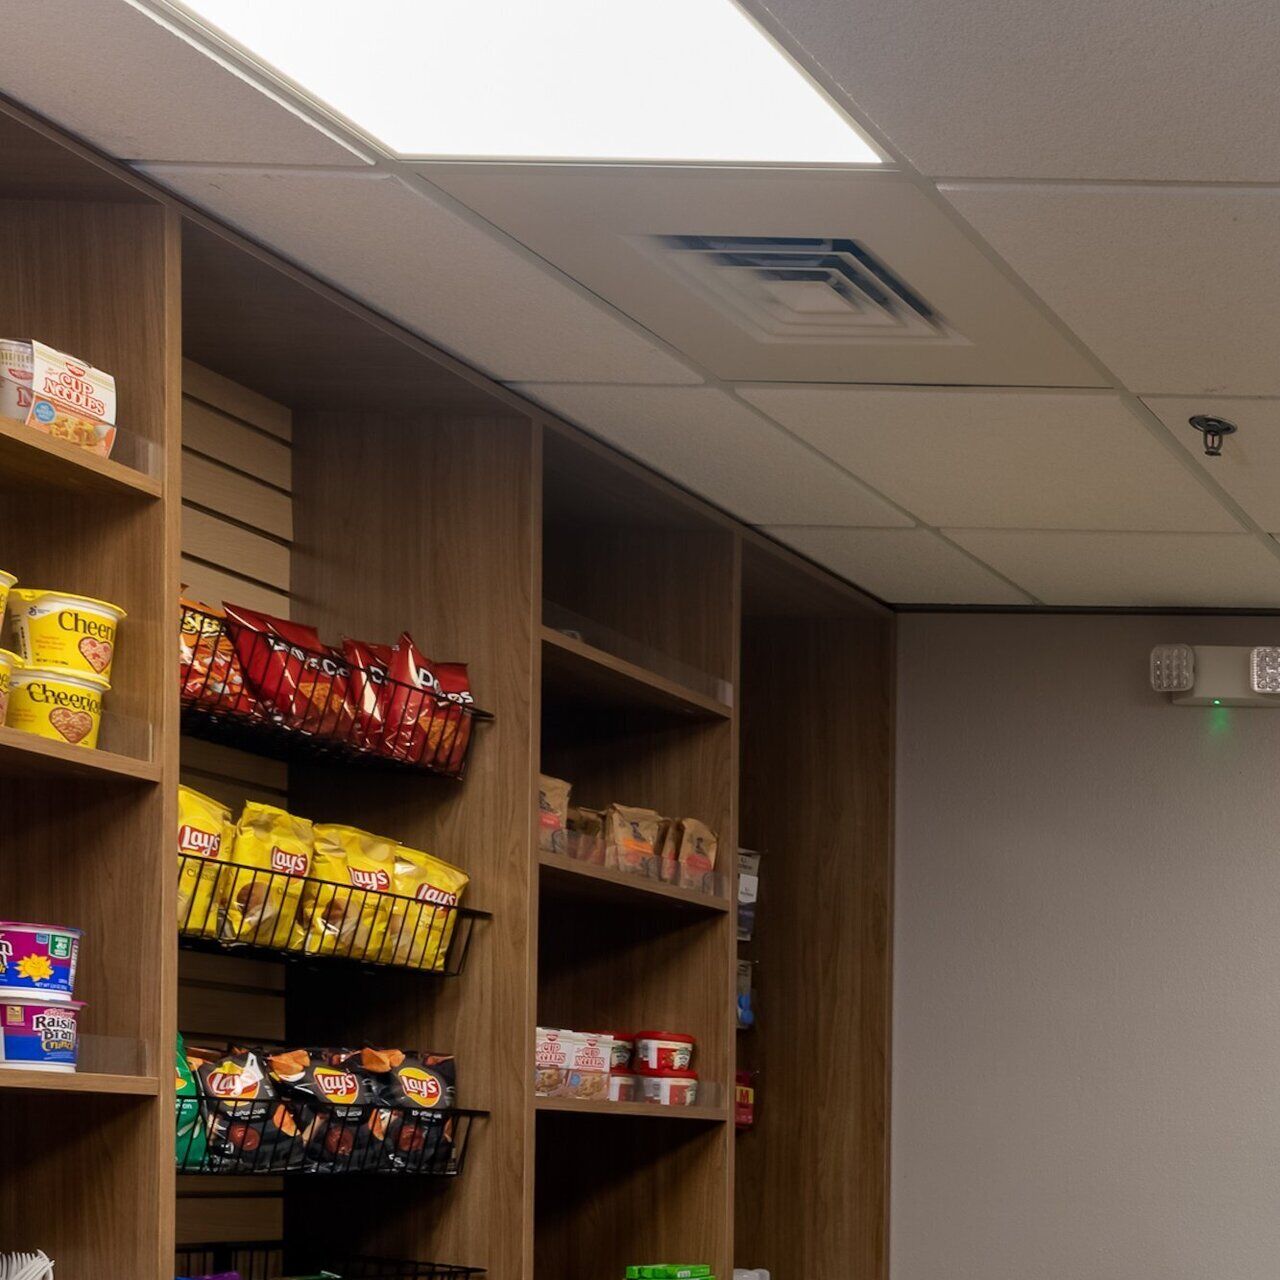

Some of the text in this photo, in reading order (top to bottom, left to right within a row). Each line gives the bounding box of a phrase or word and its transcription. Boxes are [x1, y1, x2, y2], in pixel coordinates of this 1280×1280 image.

[59, 372, 94, 395] CUP
[43, 377, 105, 416] NOODLES
[182, 826, 220, 858] Lay's
[272, 848, 306, 874] Lay's
[316, 1071, 356, 1096] Lay's
[402, 1077, 438, 1098] Lay's
